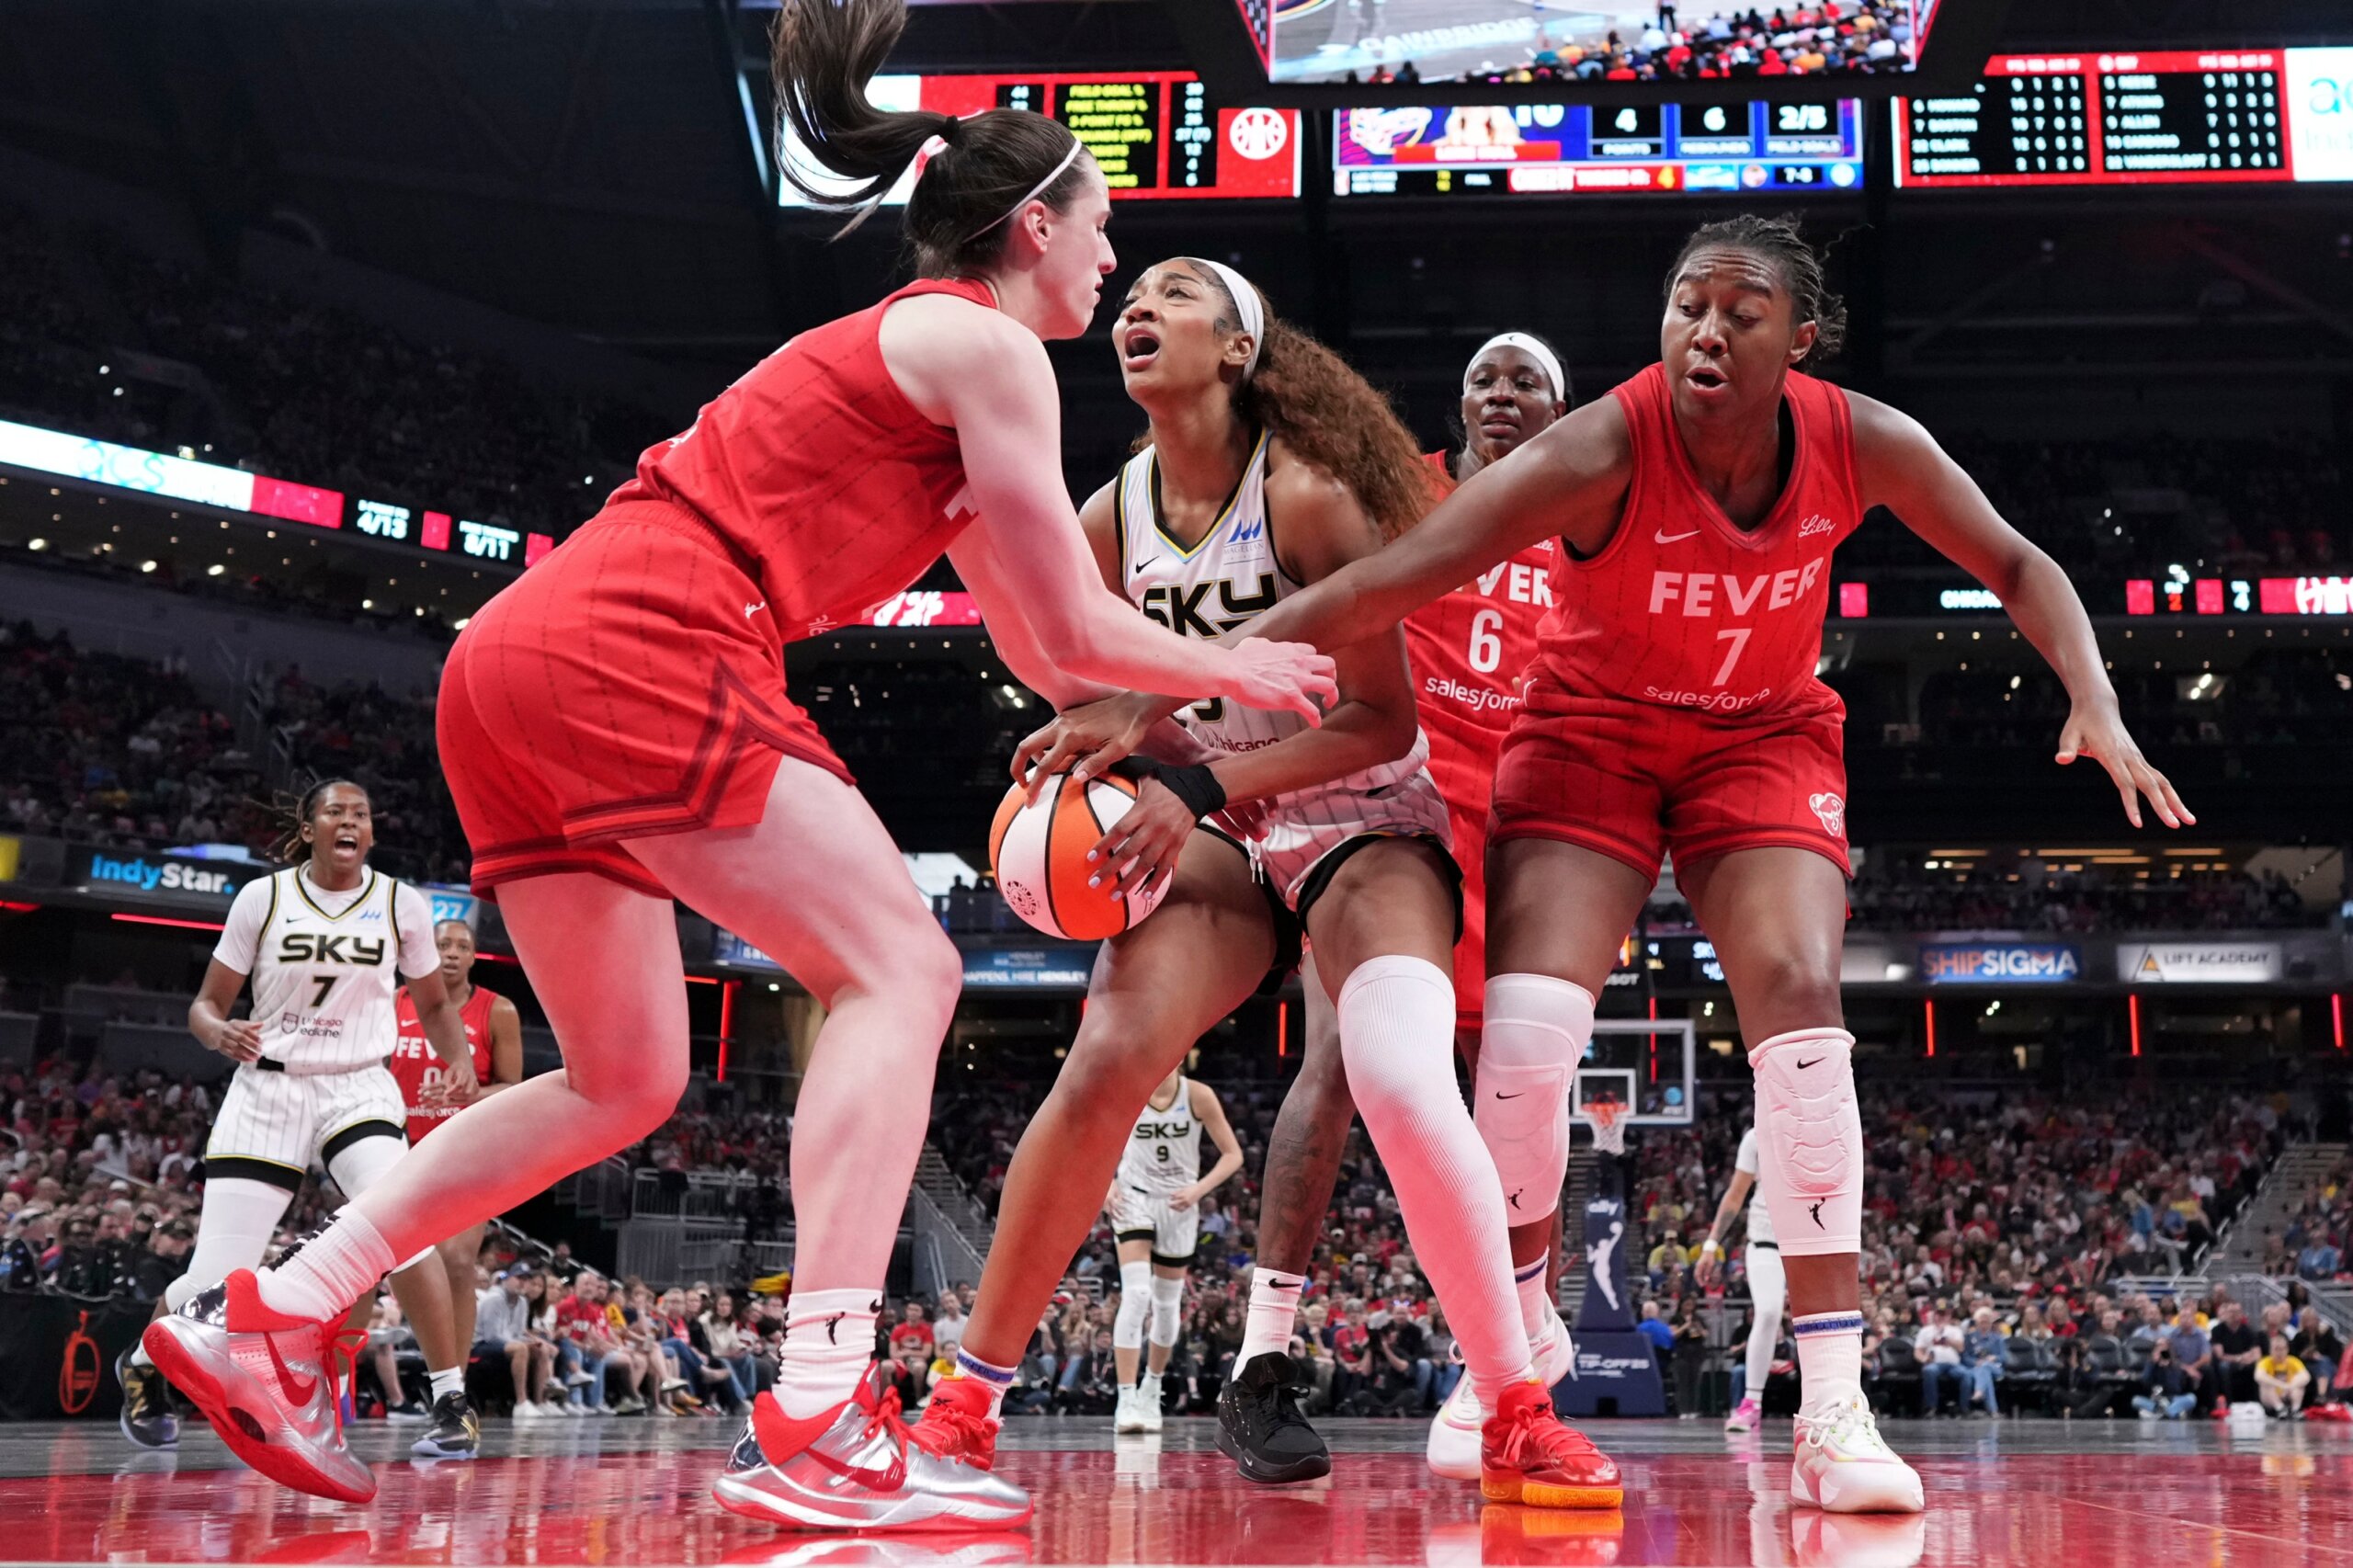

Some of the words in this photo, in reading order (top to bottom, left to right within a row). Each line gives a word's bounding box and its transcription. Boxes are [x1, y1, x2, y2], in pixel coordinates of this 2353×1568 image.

[1615, 108, 1637, 132] 4
[1799, 514, 1836, 538] Lilly
[1456, 561, 1553, 608] VER
[1648, 557, 1824, 617] FEVER
[1142, 571, 1281, 640] SKY
[1469, 609, 1503, 673] 6
[1712, 629, 1752, 687] 7
[434, 901, 463, 920] 27
[278, 933, 384, 966] SKY
[2198, 950, 2269, 966] ACADEMY
[1924, 949, 2078, 977] SHIPSIGMA
[313, 975, 338, 1007] 7
[301, 1027, 340, 1039] edicine
[396, 1036, 476, 1061] FEV
[1135, 1120, 1189, 1140] SKY
[1156, 1145, 1170, 1163] 9
